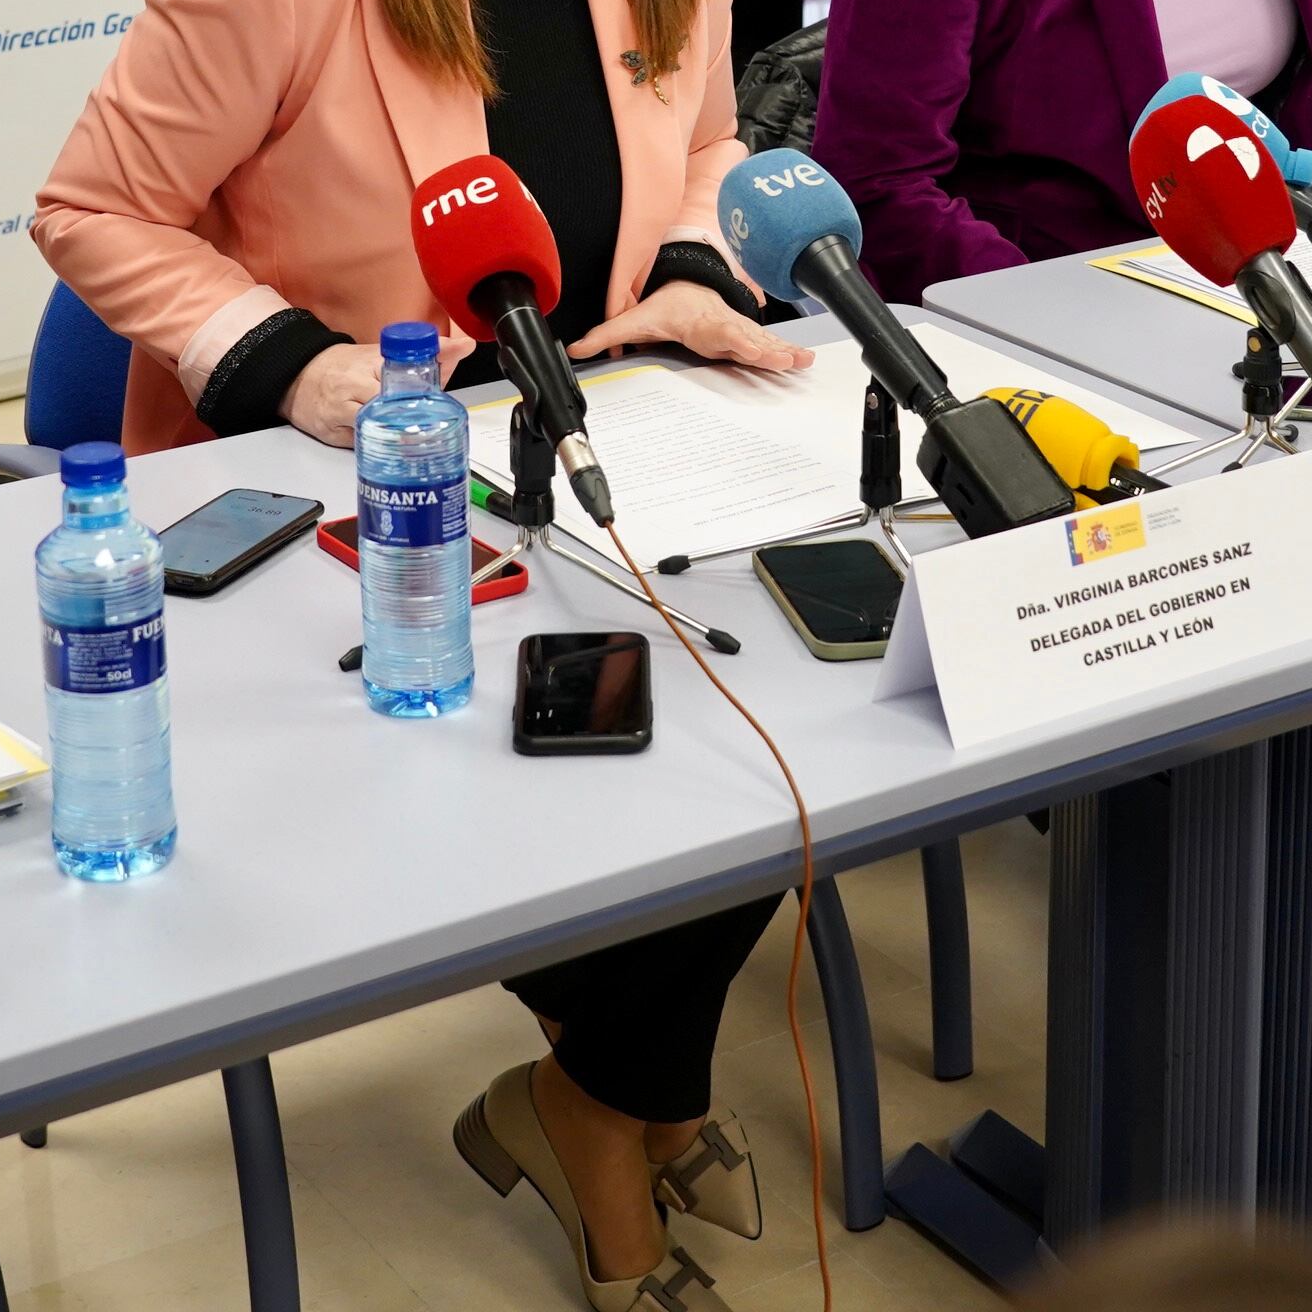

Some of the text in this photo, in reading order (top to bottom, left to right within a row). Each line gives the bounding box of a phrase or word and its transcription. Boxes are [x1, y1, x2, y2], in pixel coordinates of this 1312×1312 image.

[422, 177, 499, 226] rne
[753, 164, 826, 197] tve
[358, 482, 438, 506] UENSANTA
[1017, 543, 1252, 620] Dña. VIRGINIA BARCONES SANZ
[1031, 578, 1250, 652] DELEGADA DEL GOBIERNO EN
[1084, 617, 1213, 666] CASTILLA Y LEÓN
